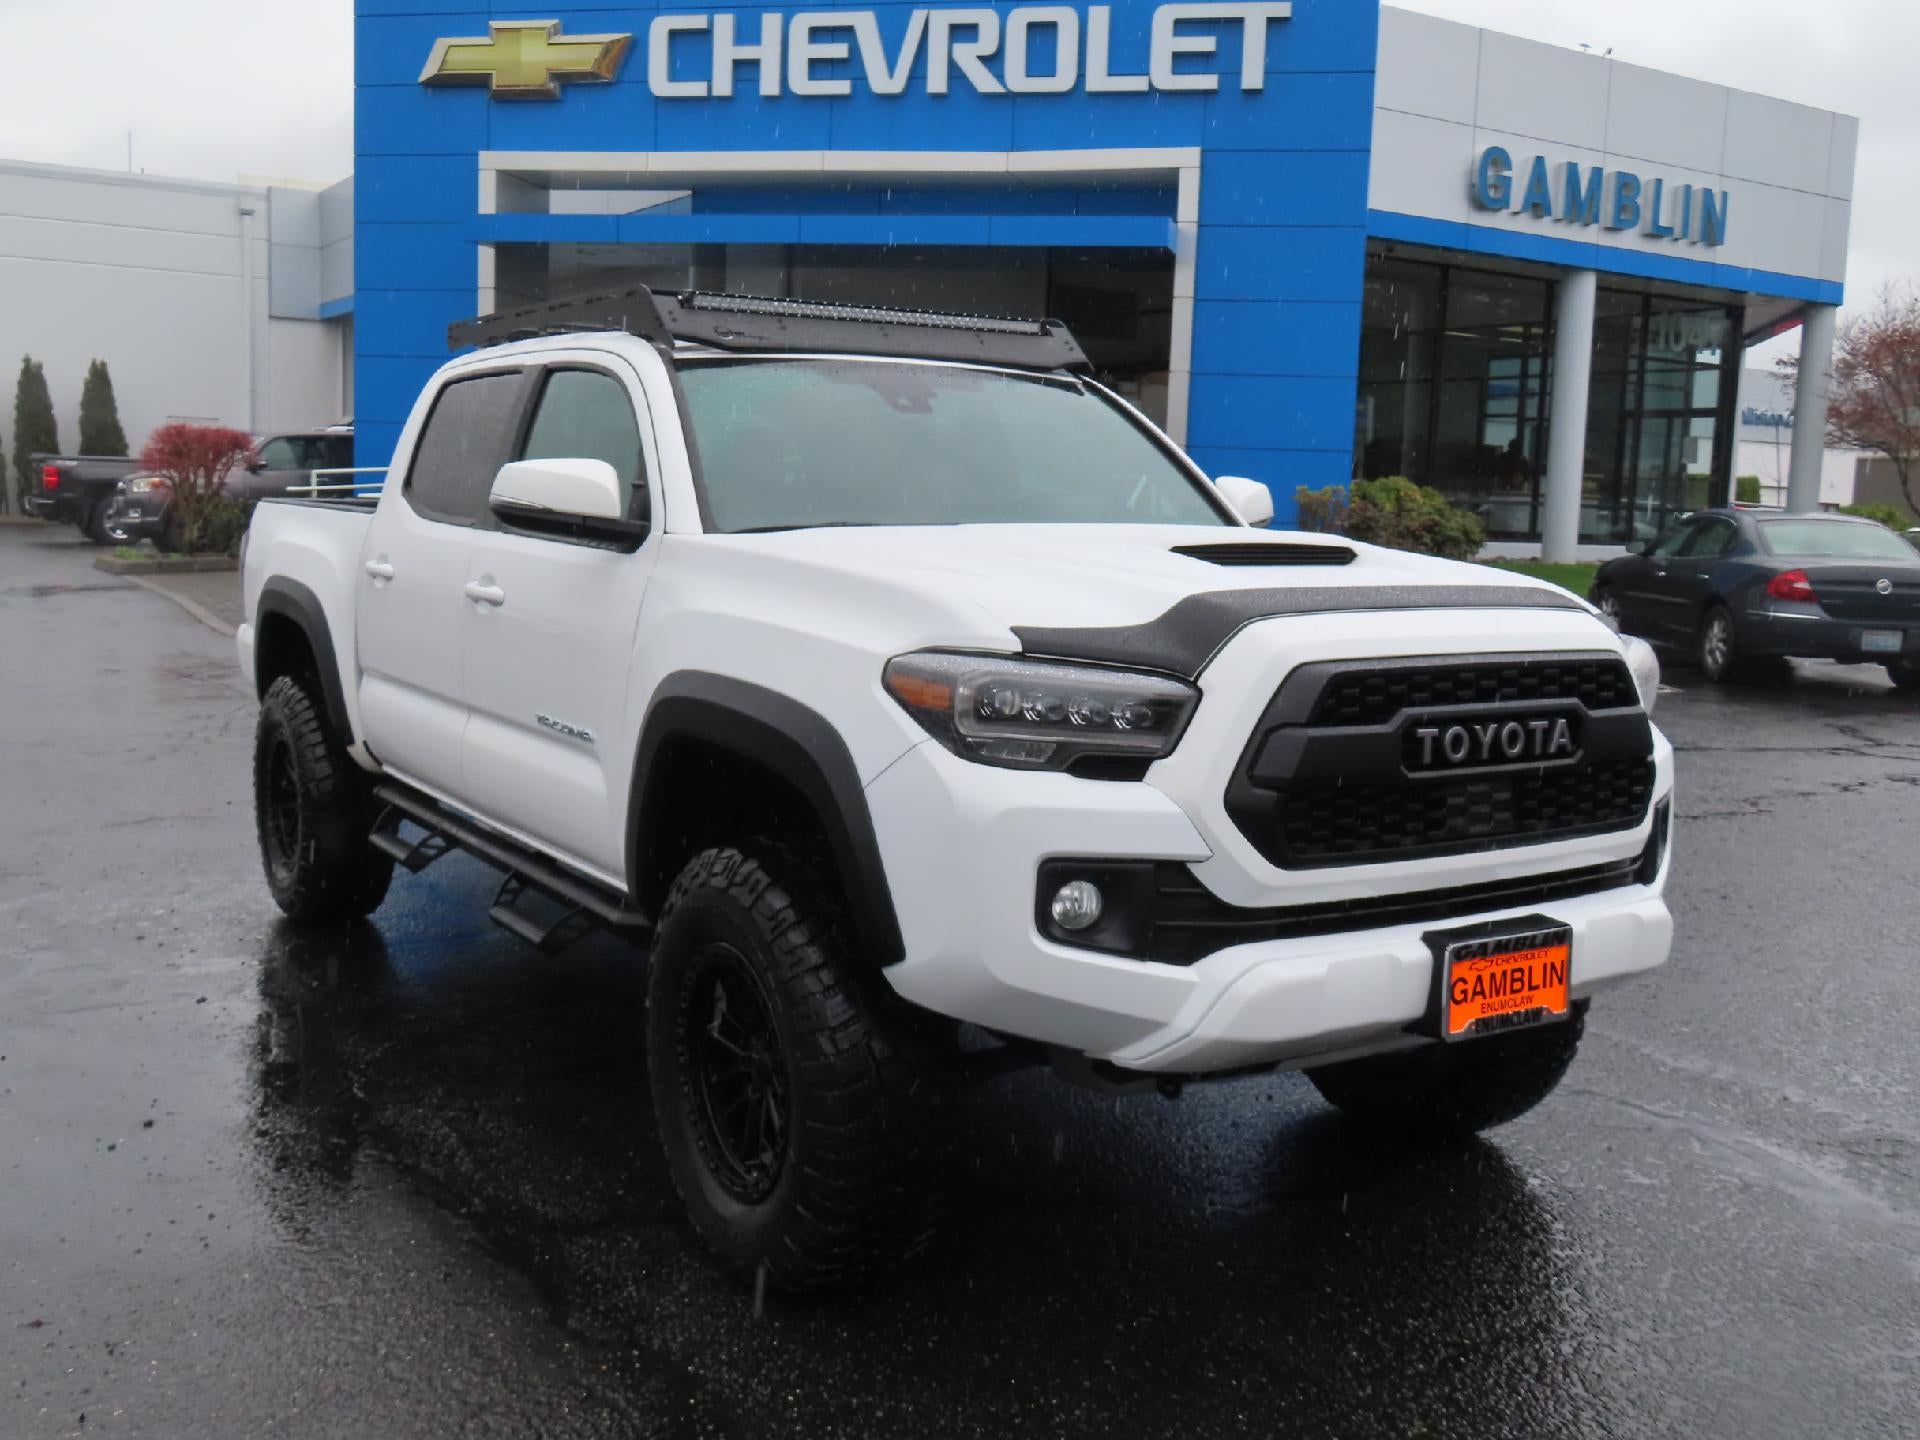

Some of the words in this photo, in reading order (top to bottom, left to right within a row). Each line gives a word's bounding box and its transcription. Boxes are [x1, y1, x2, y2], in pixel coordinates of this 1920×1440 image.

[648, 2, 1292, 98] CHEVROLET
[1475, 145, 1728, 246] GAMBLIN
[1416, 718, 1573, 764] TOYOTA
[1454, 930, 1567, 960] GAMBLIN
[1495, 950, 1548, 967] CHEVROLET
[1451, 960, 1565, 1006] GAMBLIN
[1480, 995, 1534, 1014] ENUMCLAW
